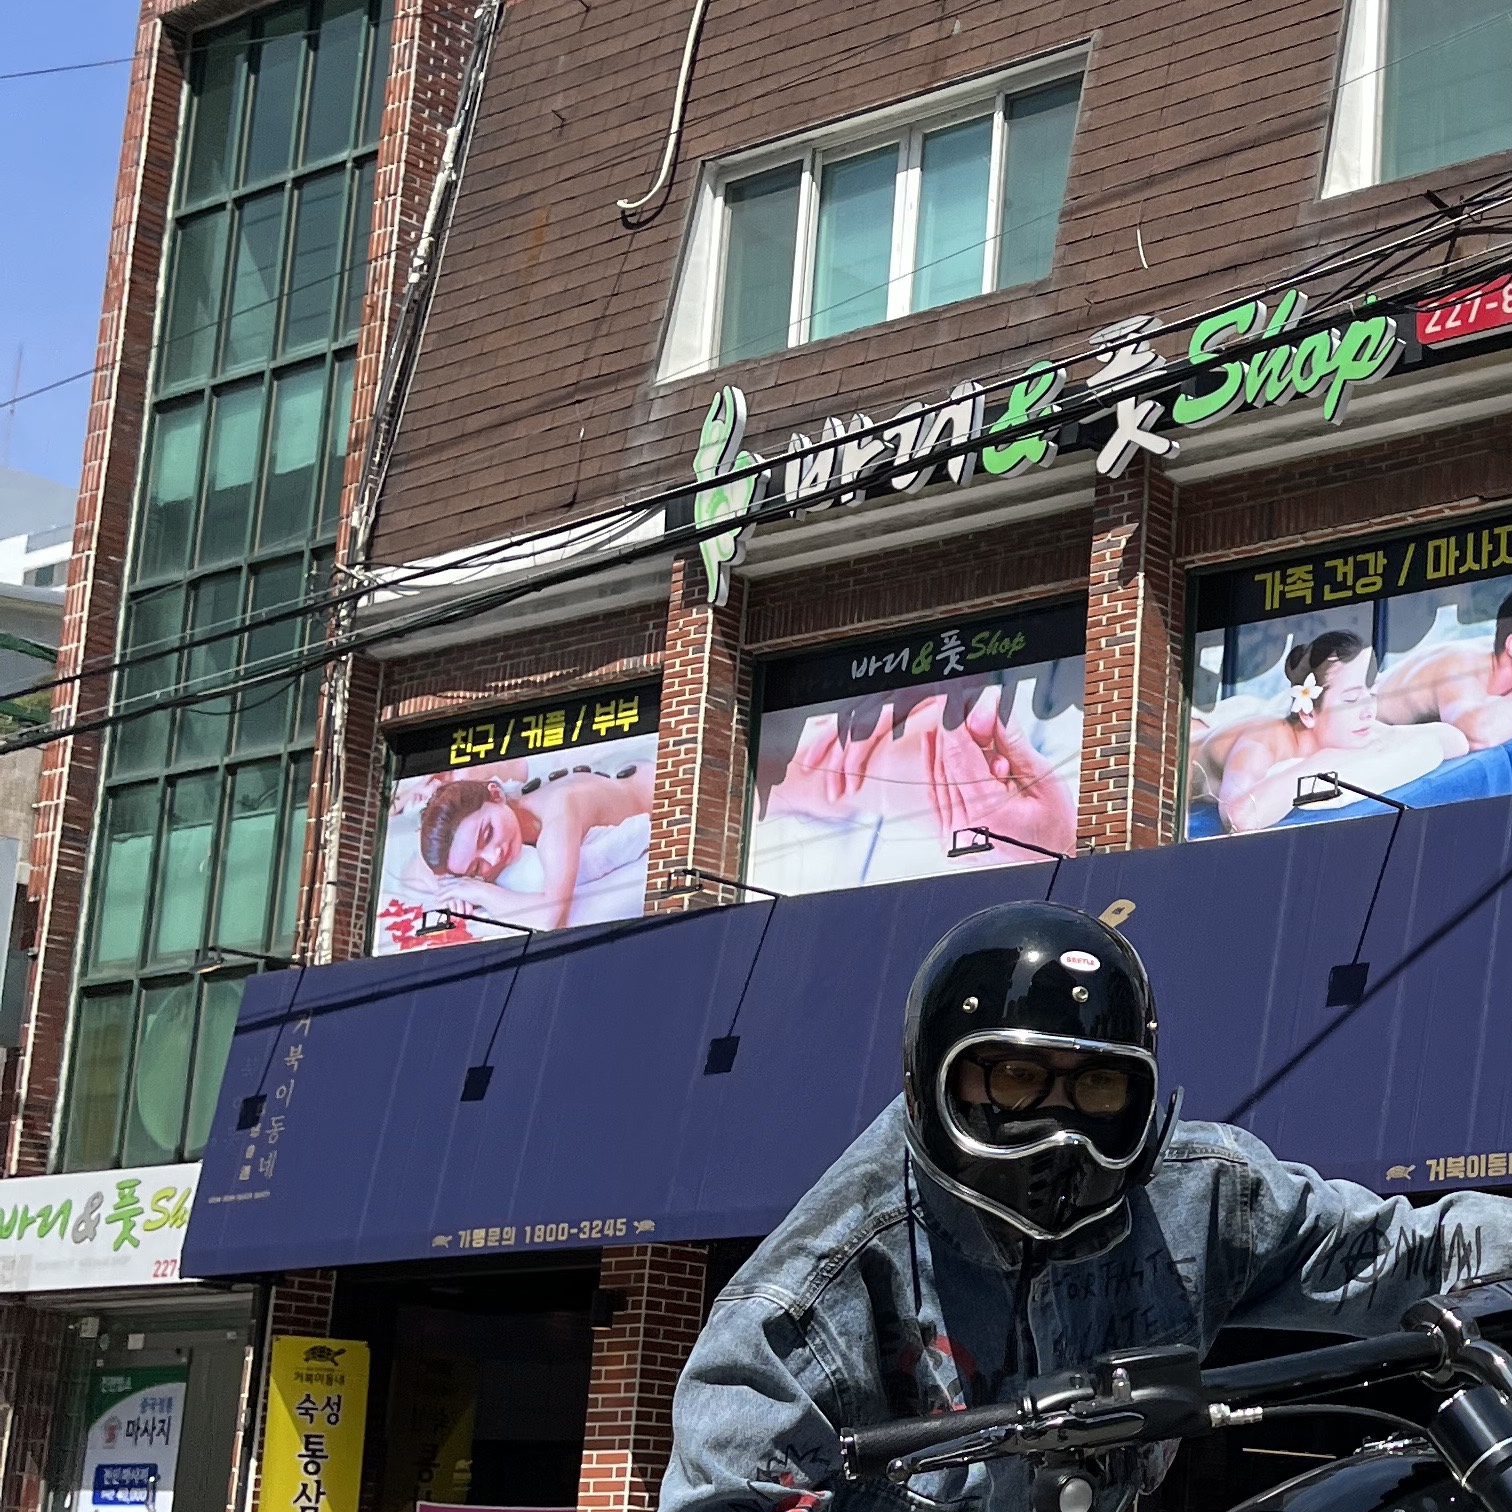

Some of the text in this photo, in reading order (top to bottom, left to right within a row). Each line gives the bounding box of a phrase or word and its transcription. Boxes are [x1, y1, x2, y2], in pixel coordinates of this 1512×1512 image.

[1254, 563, 1314, 611] 가족
[1323, 551, 1388, 600] 건강
[449, 723, 495, 765] 친구
[521, 709, 567, 749] 커플
[592, 696, 640, 736] 부부
[524, 1218, 627, 1244] 1800-3245
[296, 1393, 342, 1426] 숙성
[125, 1415, 172, 1446] 마사지
